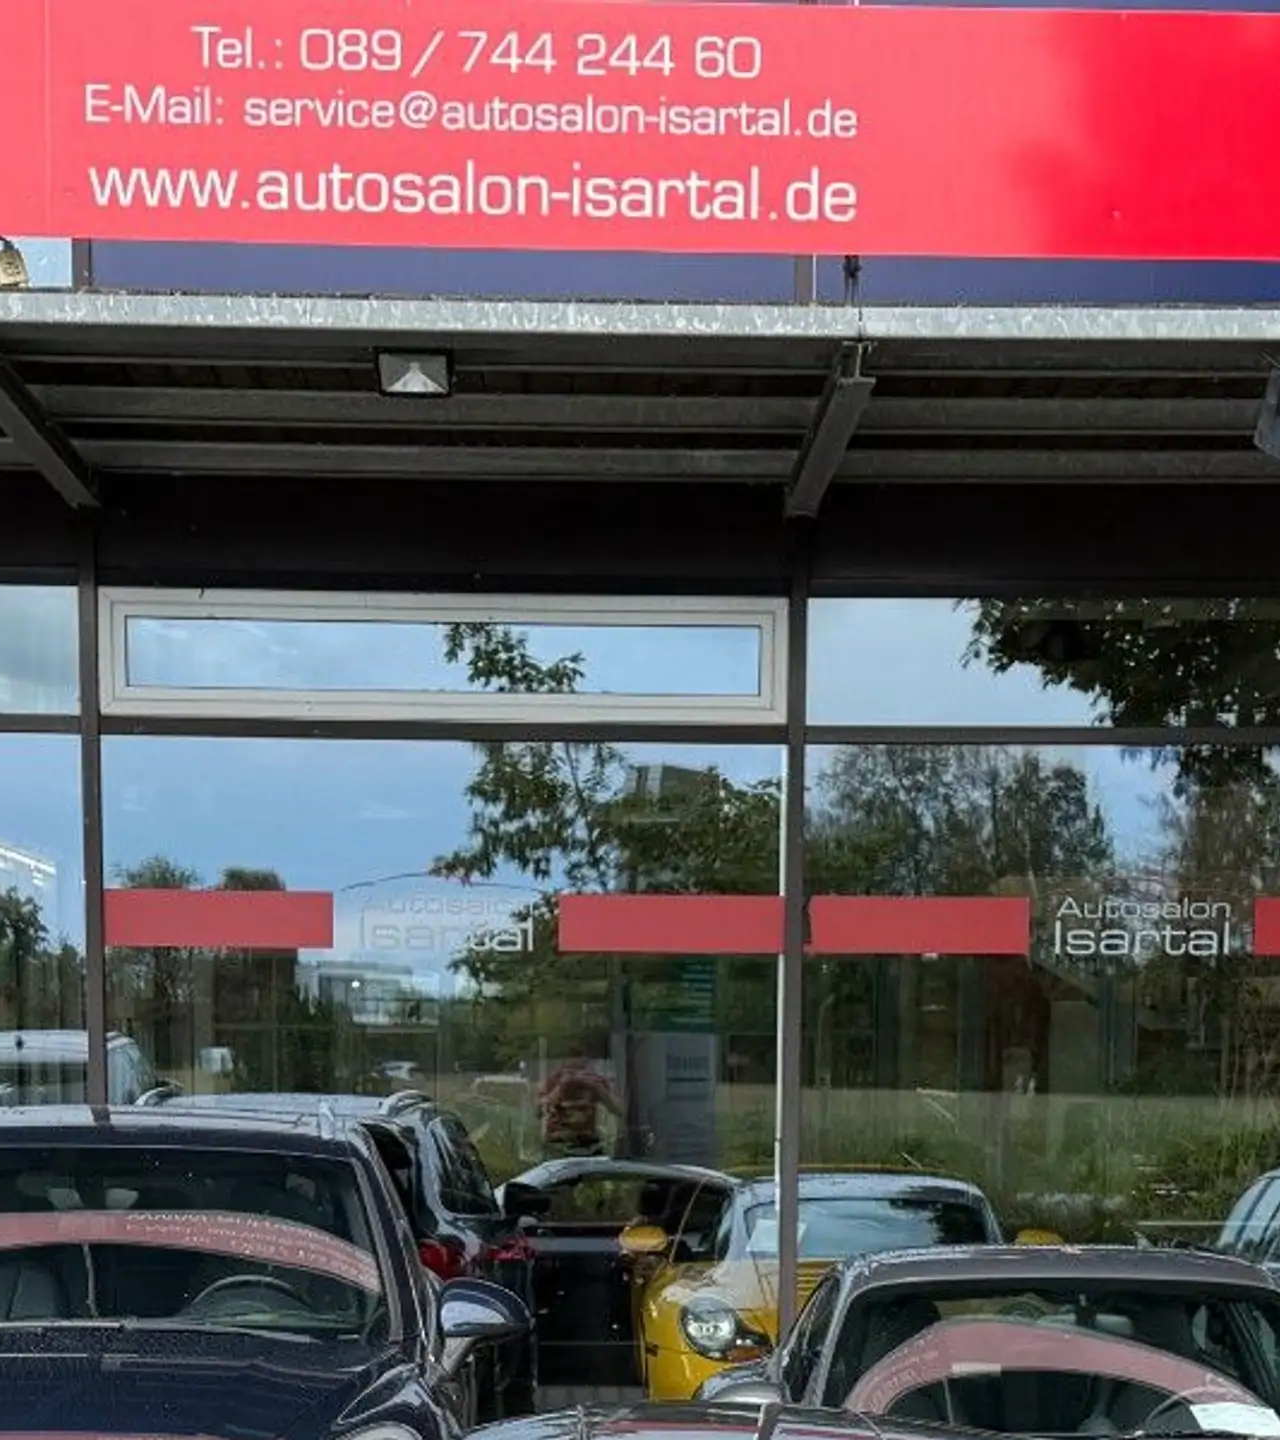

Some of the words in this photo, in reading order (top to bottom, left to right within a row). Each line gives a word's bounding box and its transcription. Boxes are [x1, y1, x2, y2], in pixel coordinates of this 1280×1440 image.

[192, 26, 283, 70] Tel.:
[300, 28, 402, 73] 089
[459, 31, 557, 75] 744
[577, 34, 676, 78] 244
[695, 36, 762, 79] 60
[85, 85, 224, 127] E-Mail:
[244, 90, 858, 139] service@autosalon-isartal.de
[88, 160, 858, 223] www.autosalon-isartal.de
[1055, 896, 1232, 919] Autosalon
[359, 911, 534, 953] Isartal
[1054, 918, 1232, 957] Isartal
